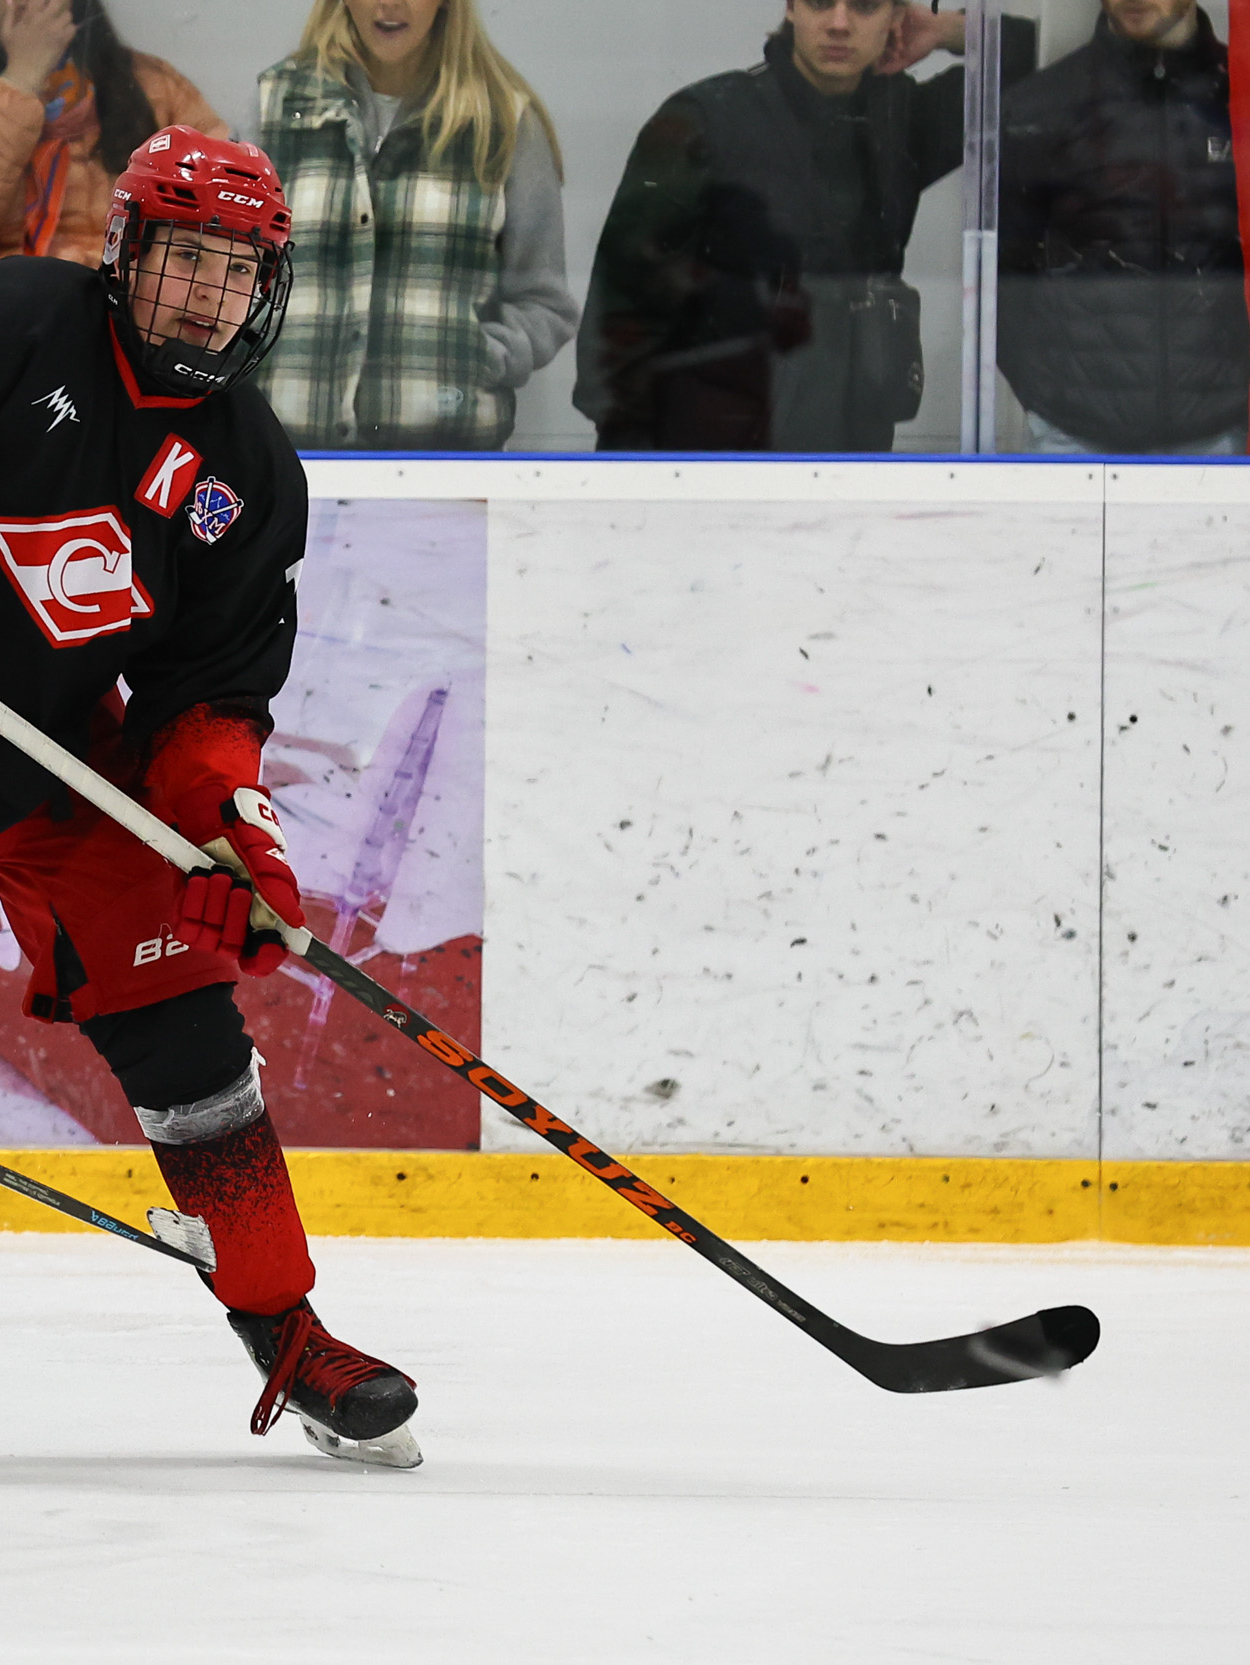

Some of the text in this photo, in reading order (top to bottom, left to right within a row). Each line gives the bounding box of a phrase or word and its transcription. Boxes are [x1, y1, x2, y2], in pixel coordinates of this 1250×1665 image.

[113, 187, 133, 202] CCM
[217, 189, 265, 209] CCM
[416, 1029, 676, 1216] SOYUZ
[97, 1215, 140, 1241] BAUER
